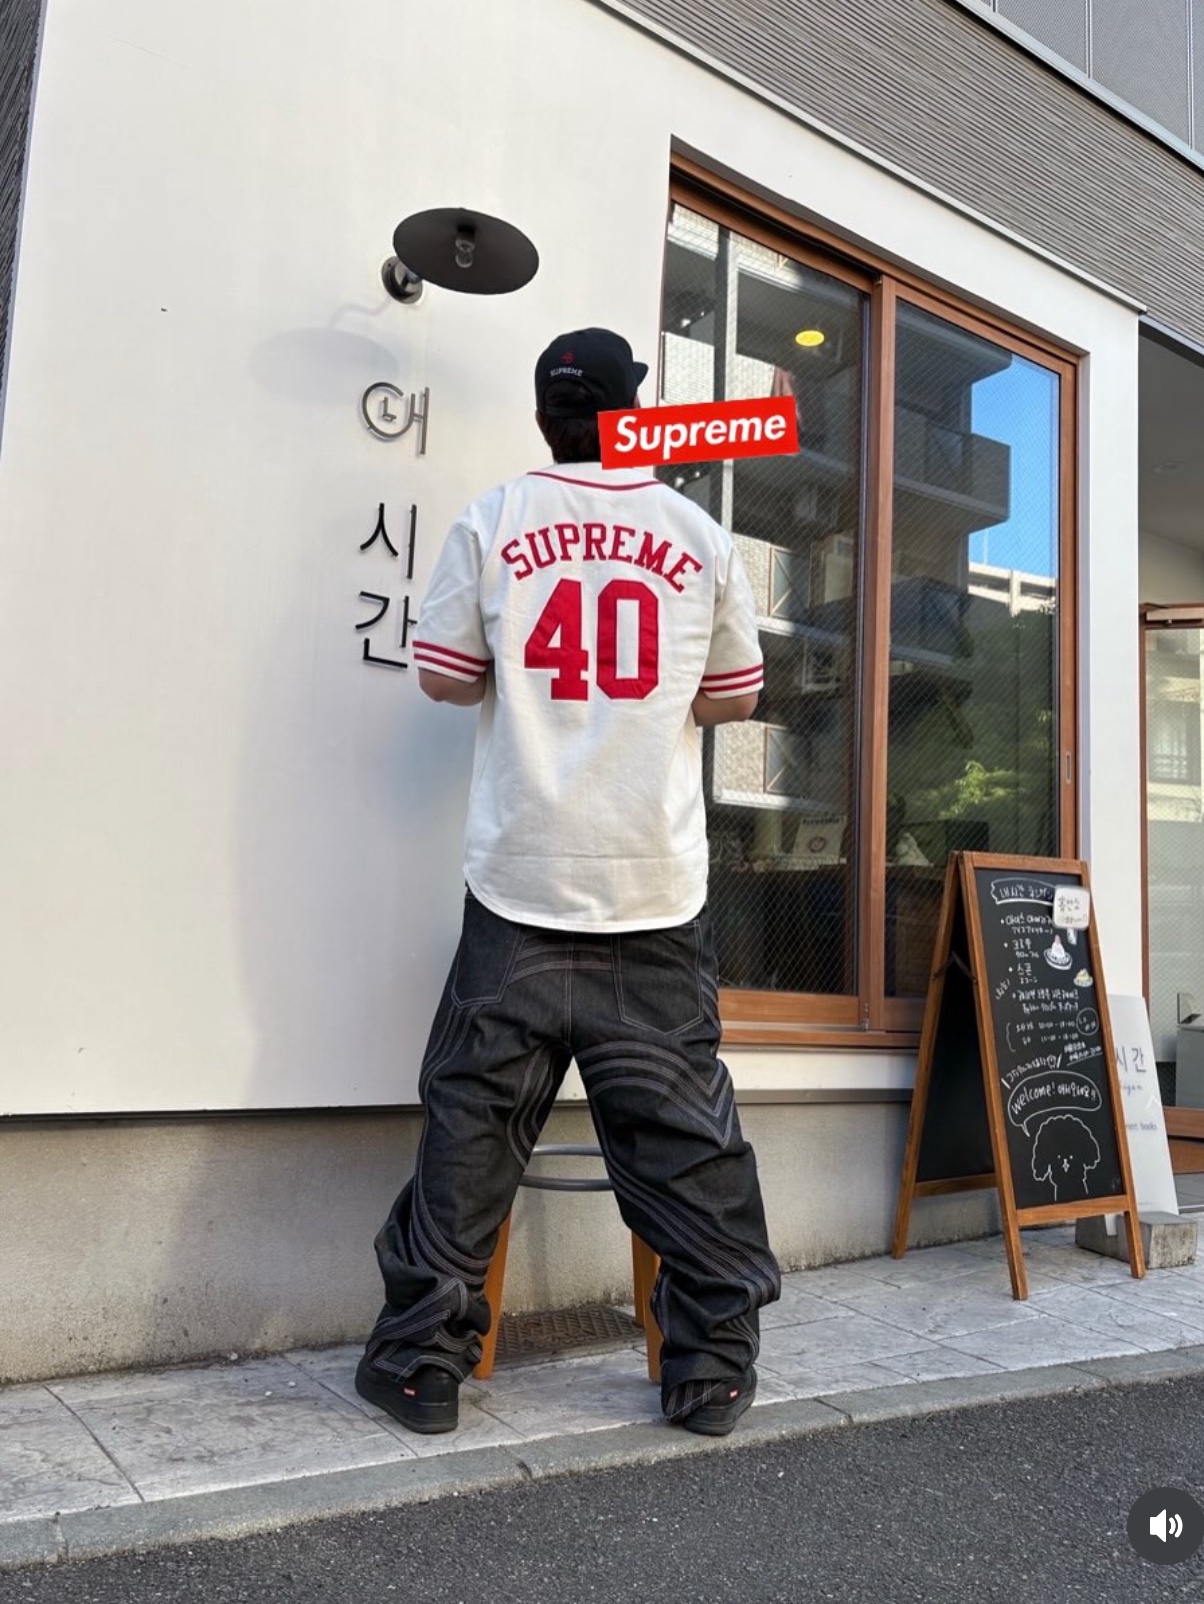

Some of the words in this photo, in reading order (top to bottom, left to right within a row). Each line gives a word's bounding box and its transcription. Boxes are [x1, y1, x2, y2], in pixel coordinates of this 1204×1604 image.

[550, 367, 583, 377] SUPREME
[501, 523, 703, 593] SUPREME
[524, 578, 660, 702] 40
[1011, 1081, 1055, 1114] welcome!
